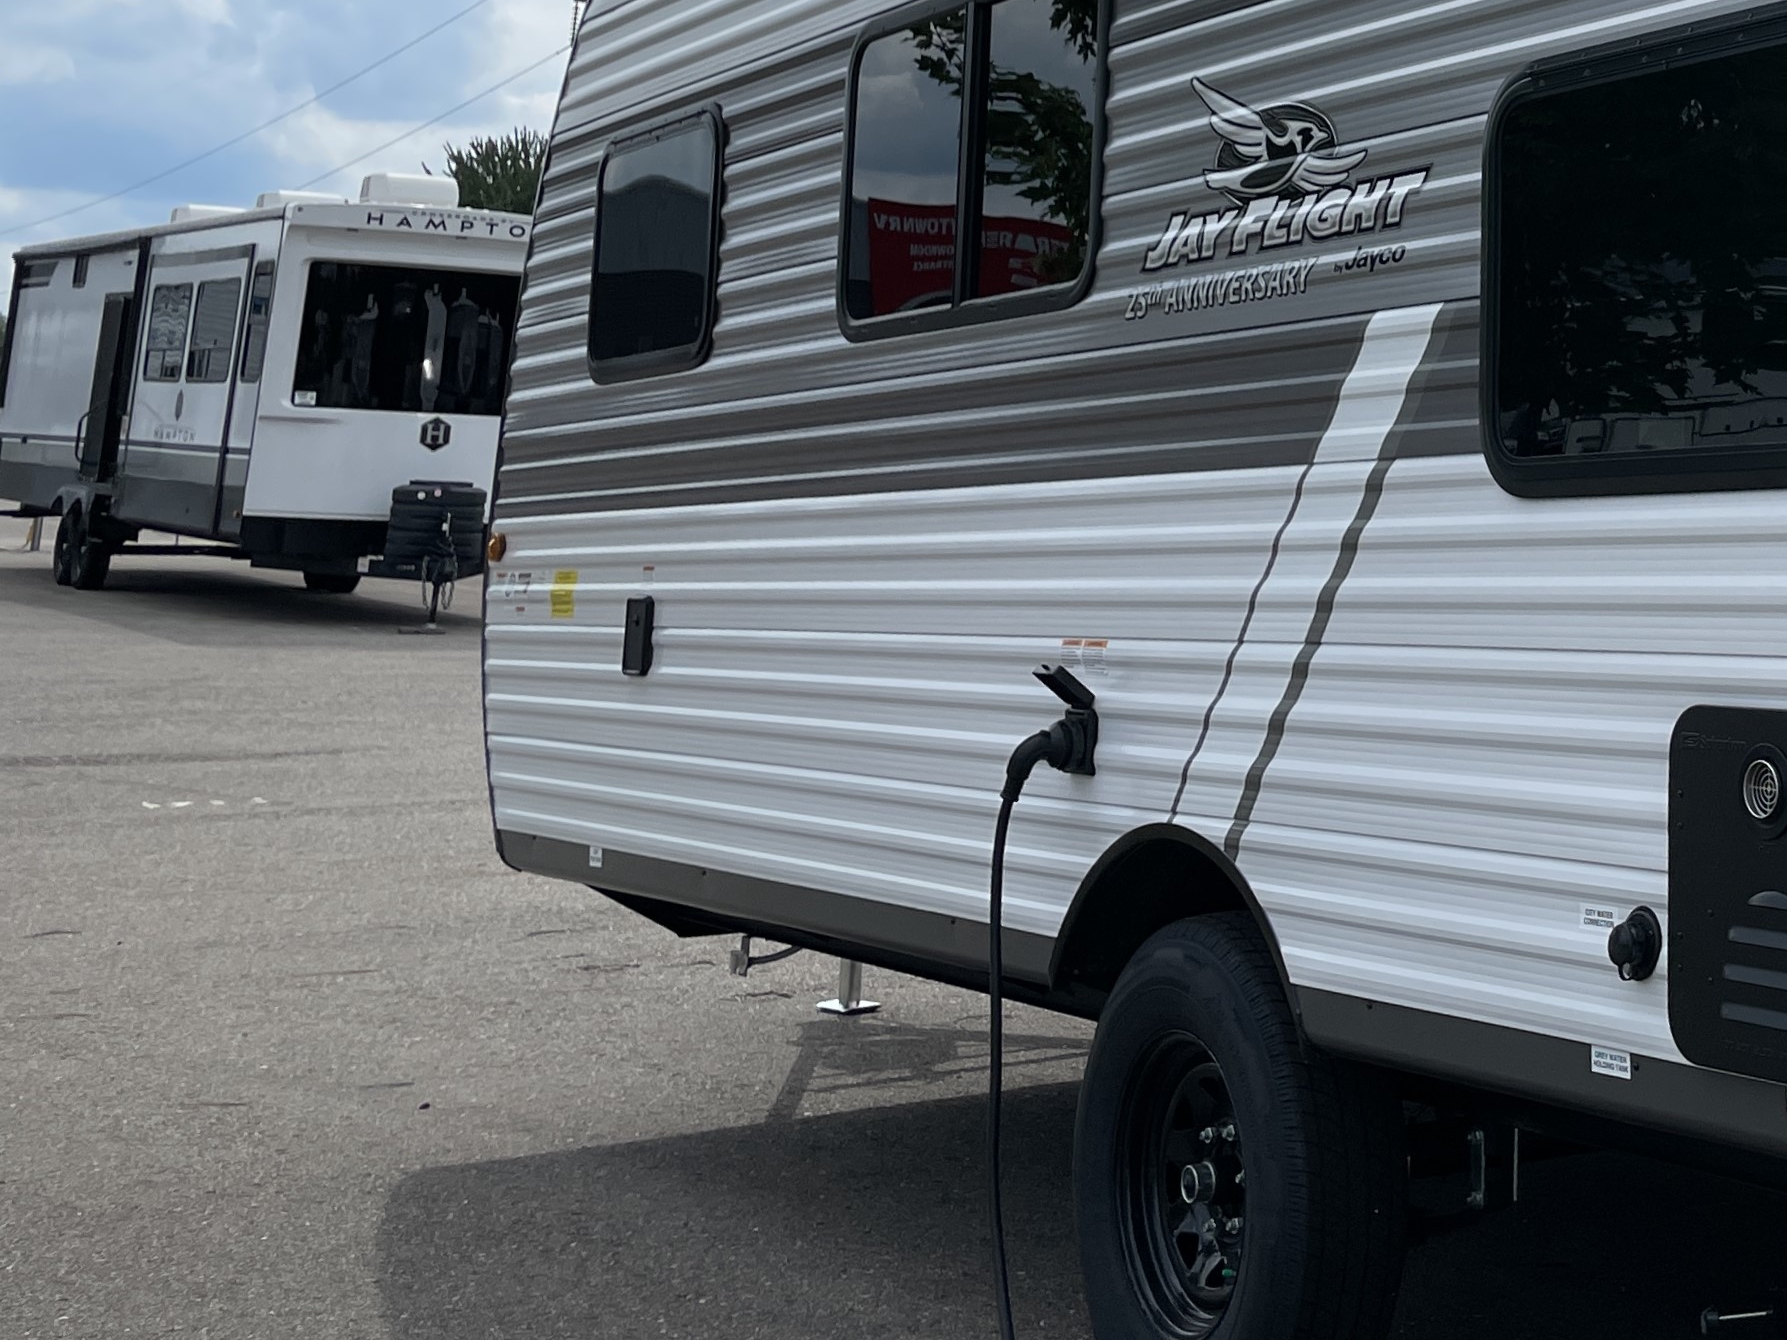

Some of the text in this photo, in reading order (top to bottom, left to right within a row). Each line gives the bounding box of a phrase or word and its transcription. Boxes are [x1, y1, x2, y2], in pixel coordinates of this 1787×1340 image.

[366, 211, 526, 238] HAMPTO
[1344, 245, 1407, 272] Jayco
[1164, 255, 1319, 314] ANNIVERSARY
